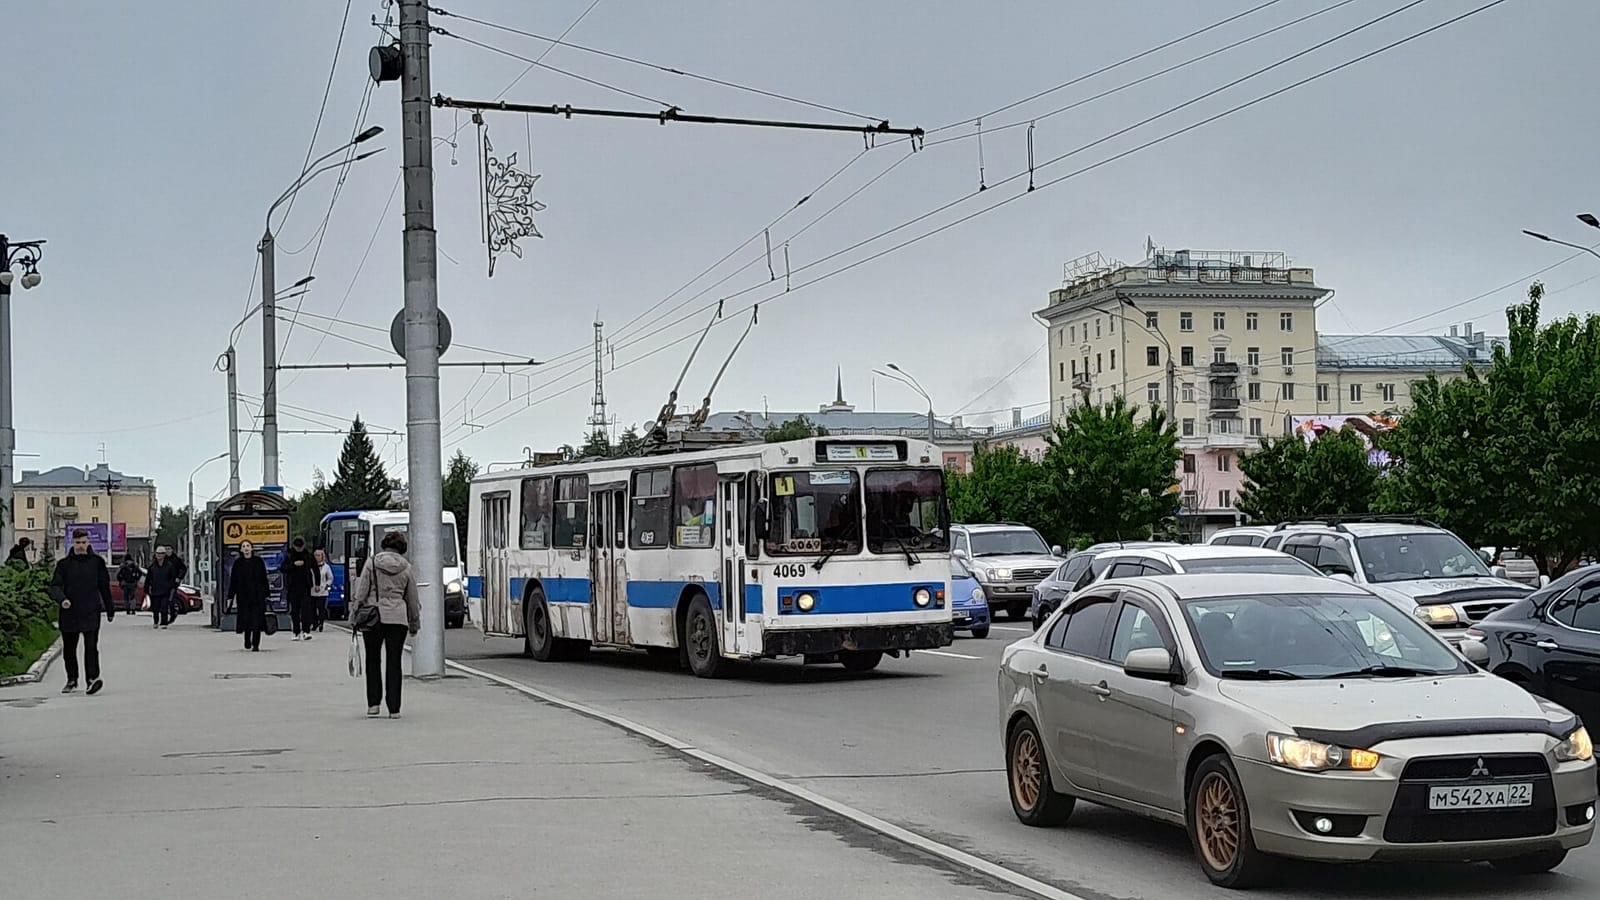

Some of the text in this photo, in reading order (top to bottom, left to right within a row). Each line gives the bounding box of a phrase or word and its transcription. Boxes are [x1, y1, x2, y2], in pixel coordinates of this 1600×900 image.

[781, 478, 789, 492] 1
[773, 564, 806, 578] 4069
[1436, 786, 1527, 806] М542ХА 22
